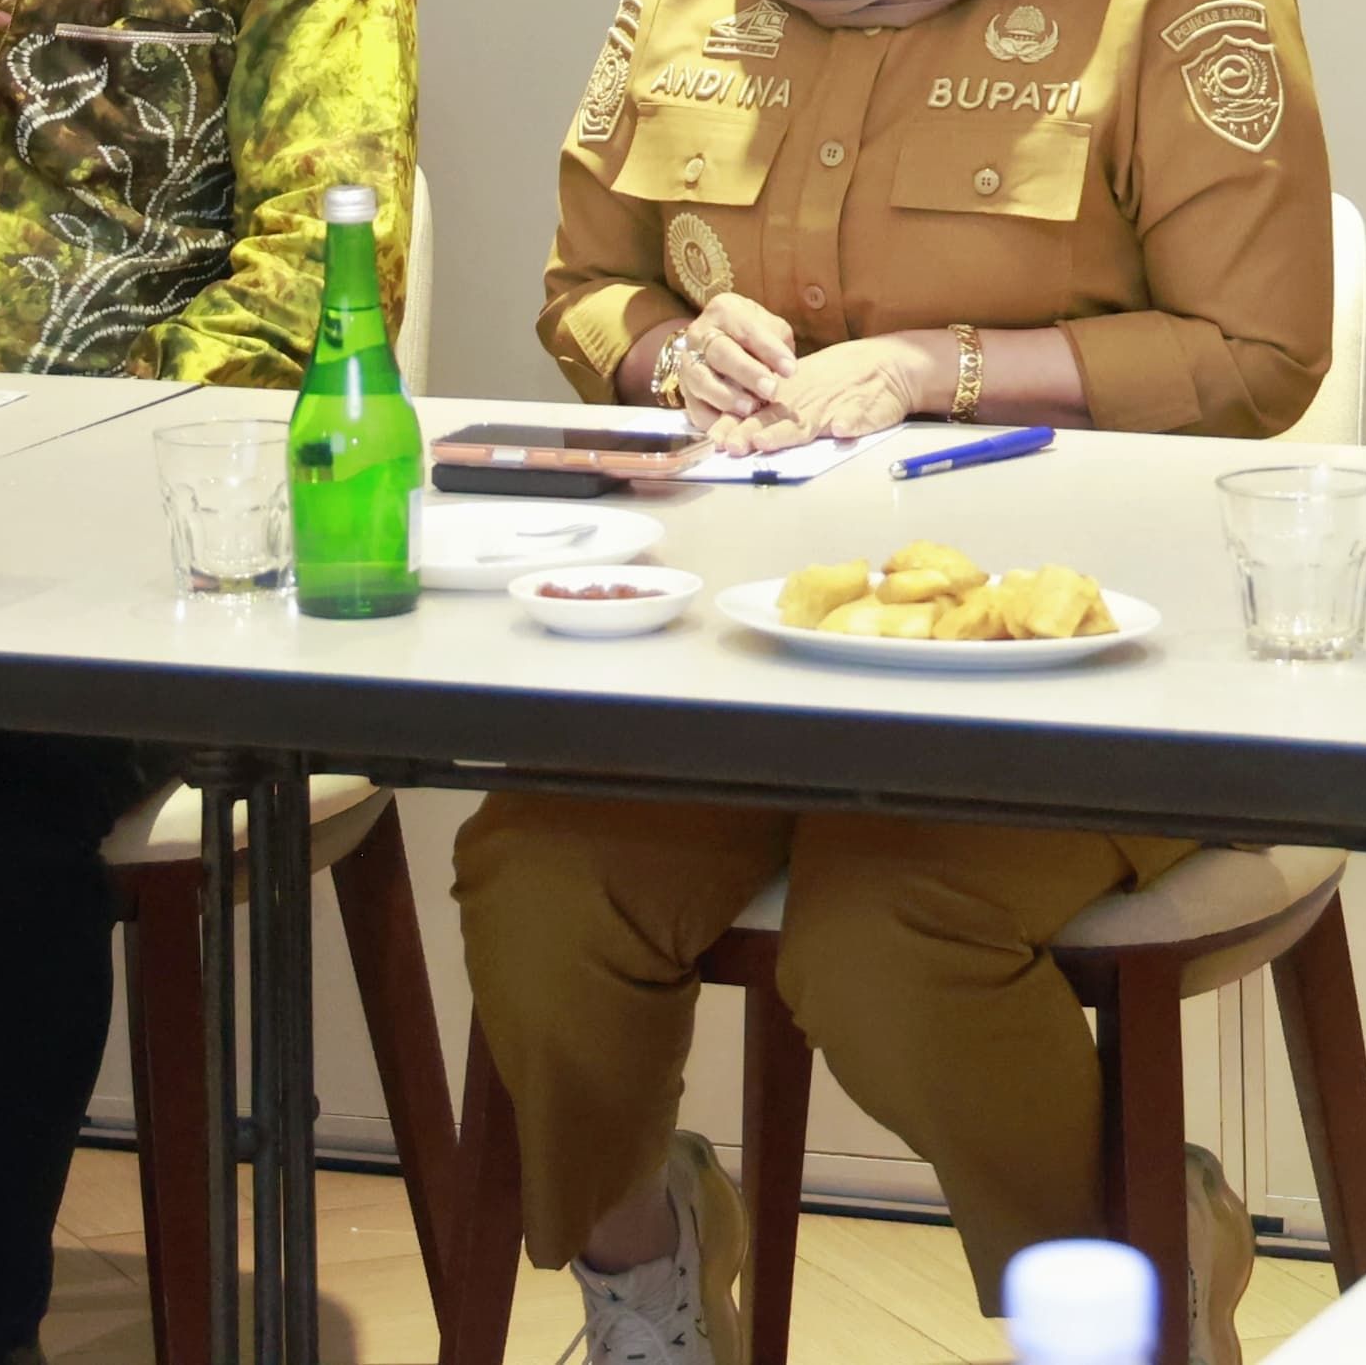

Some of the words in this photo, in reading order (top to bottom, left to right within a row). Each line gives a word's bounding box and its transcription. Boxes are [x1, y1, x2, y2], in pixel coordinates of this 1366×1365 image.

[651, 63, 735, 104] ANDI
[737, 75, 791, 110] INA
[927, 77, 1081, 114] BUPATI
